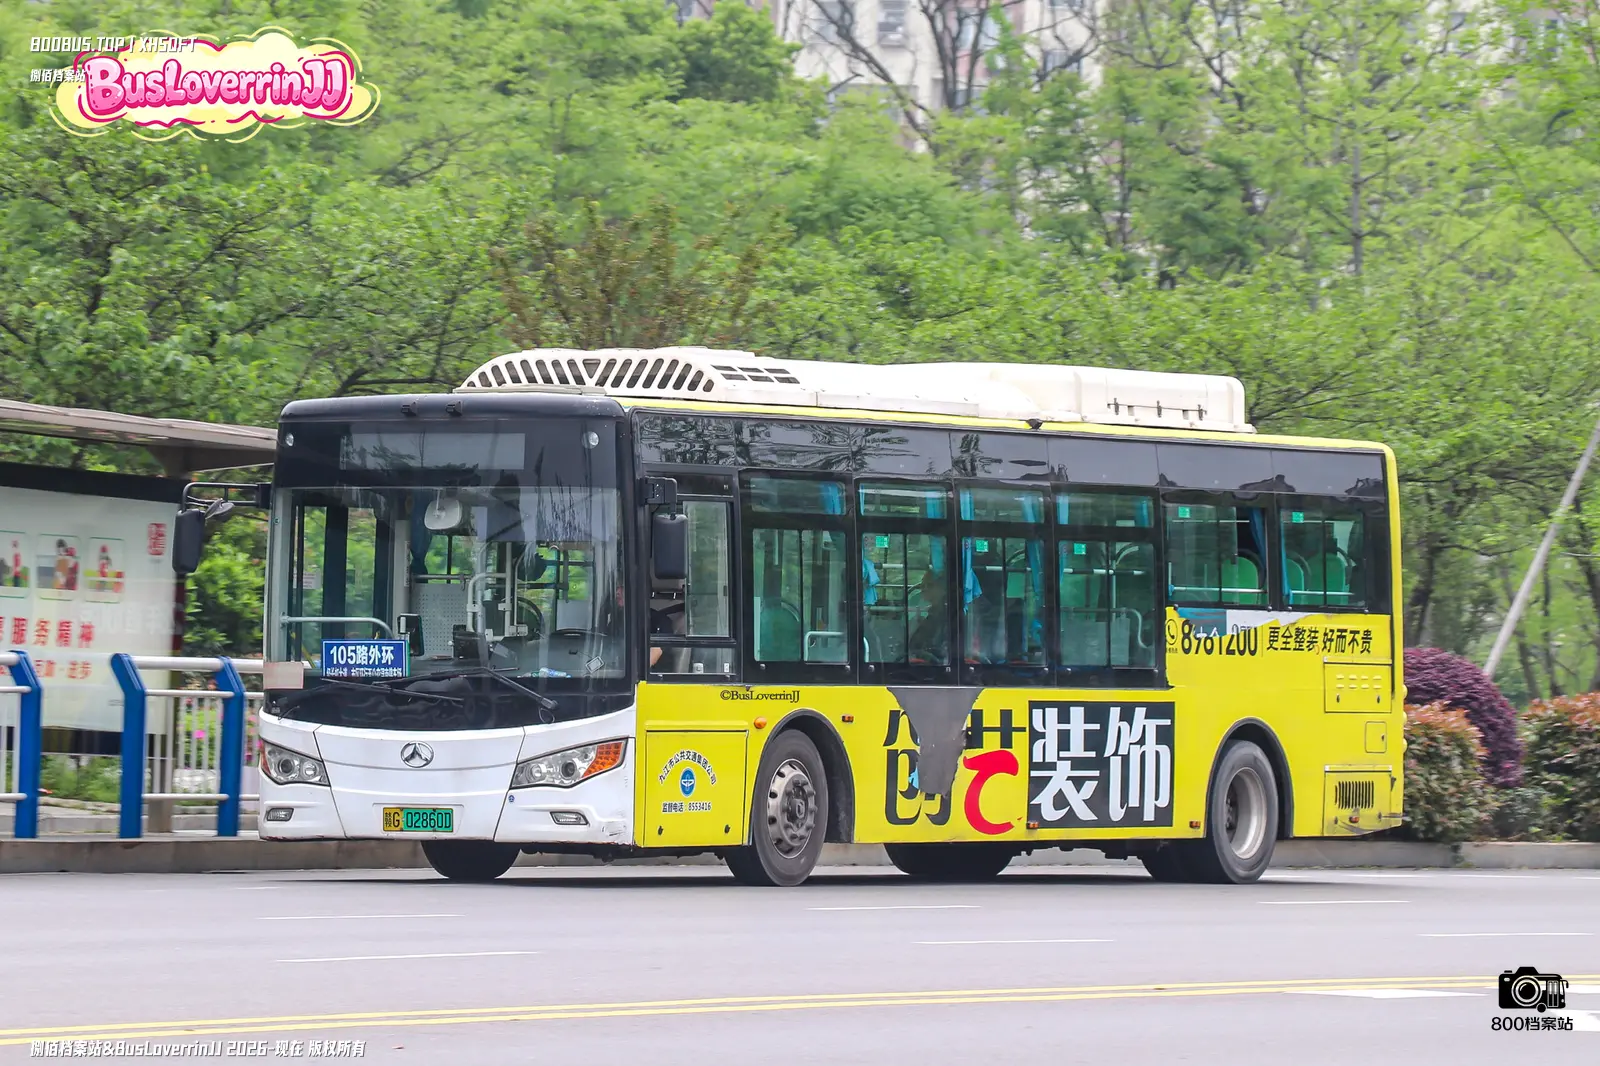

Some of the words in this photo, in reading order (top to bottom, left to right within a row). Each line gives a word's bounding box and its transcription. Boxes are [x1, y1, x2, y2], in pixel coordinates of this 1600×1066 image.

[1321, 627, 1373, 654] 好而不贵
[330, 645, 395, 666] 105路外环
